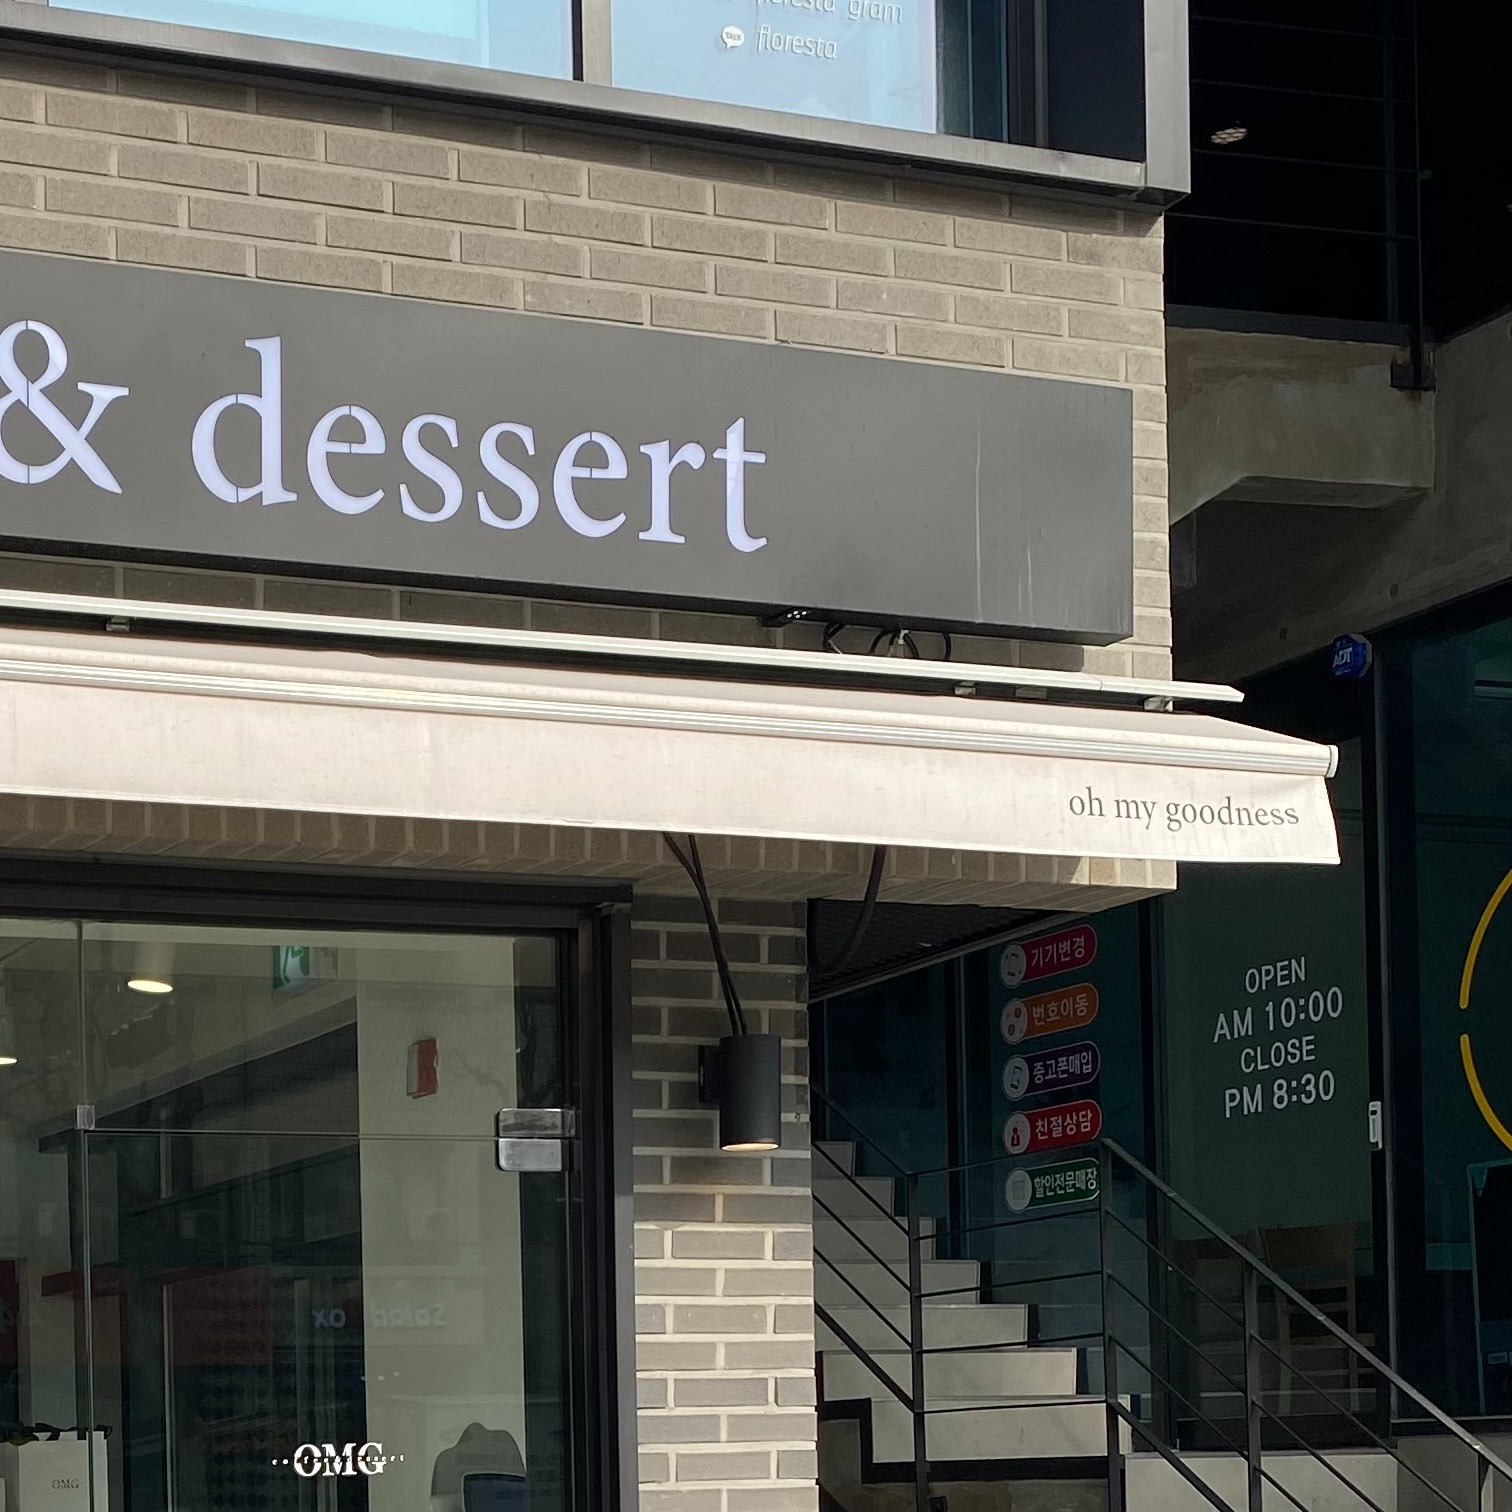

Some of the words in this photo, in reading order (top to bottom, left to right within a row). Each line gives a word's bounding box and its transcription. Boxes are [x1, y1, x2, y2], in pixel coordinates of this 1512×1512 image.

[191, 335, 769, 553] dessert
[1069, 786, 1105, 817] oh
[1114, 798, 1157, 830] my
[1166, 796, 1299, 832] goodness
[1031, 935, 1085, 968] 기기변경
[1245, 956, 1306, 994] OPEN
[1032, 993, 1089, 1026] 번호이동
[1213, 1006, 1253, 1043] AM
[1265, 986, 1343, 1031] 10:00
[1033, 1050, 1093, 1084] 중고폰매입
[1240, 1035, 1316, 1073] CLOSE
[1225, 1083, 1262, 1118] PM
[1273, 1069, 1335, 1109] 8:30
[1035, 1111, 1093, 1141] 친절상담
[293, 1442, 387, 1477] OMG
